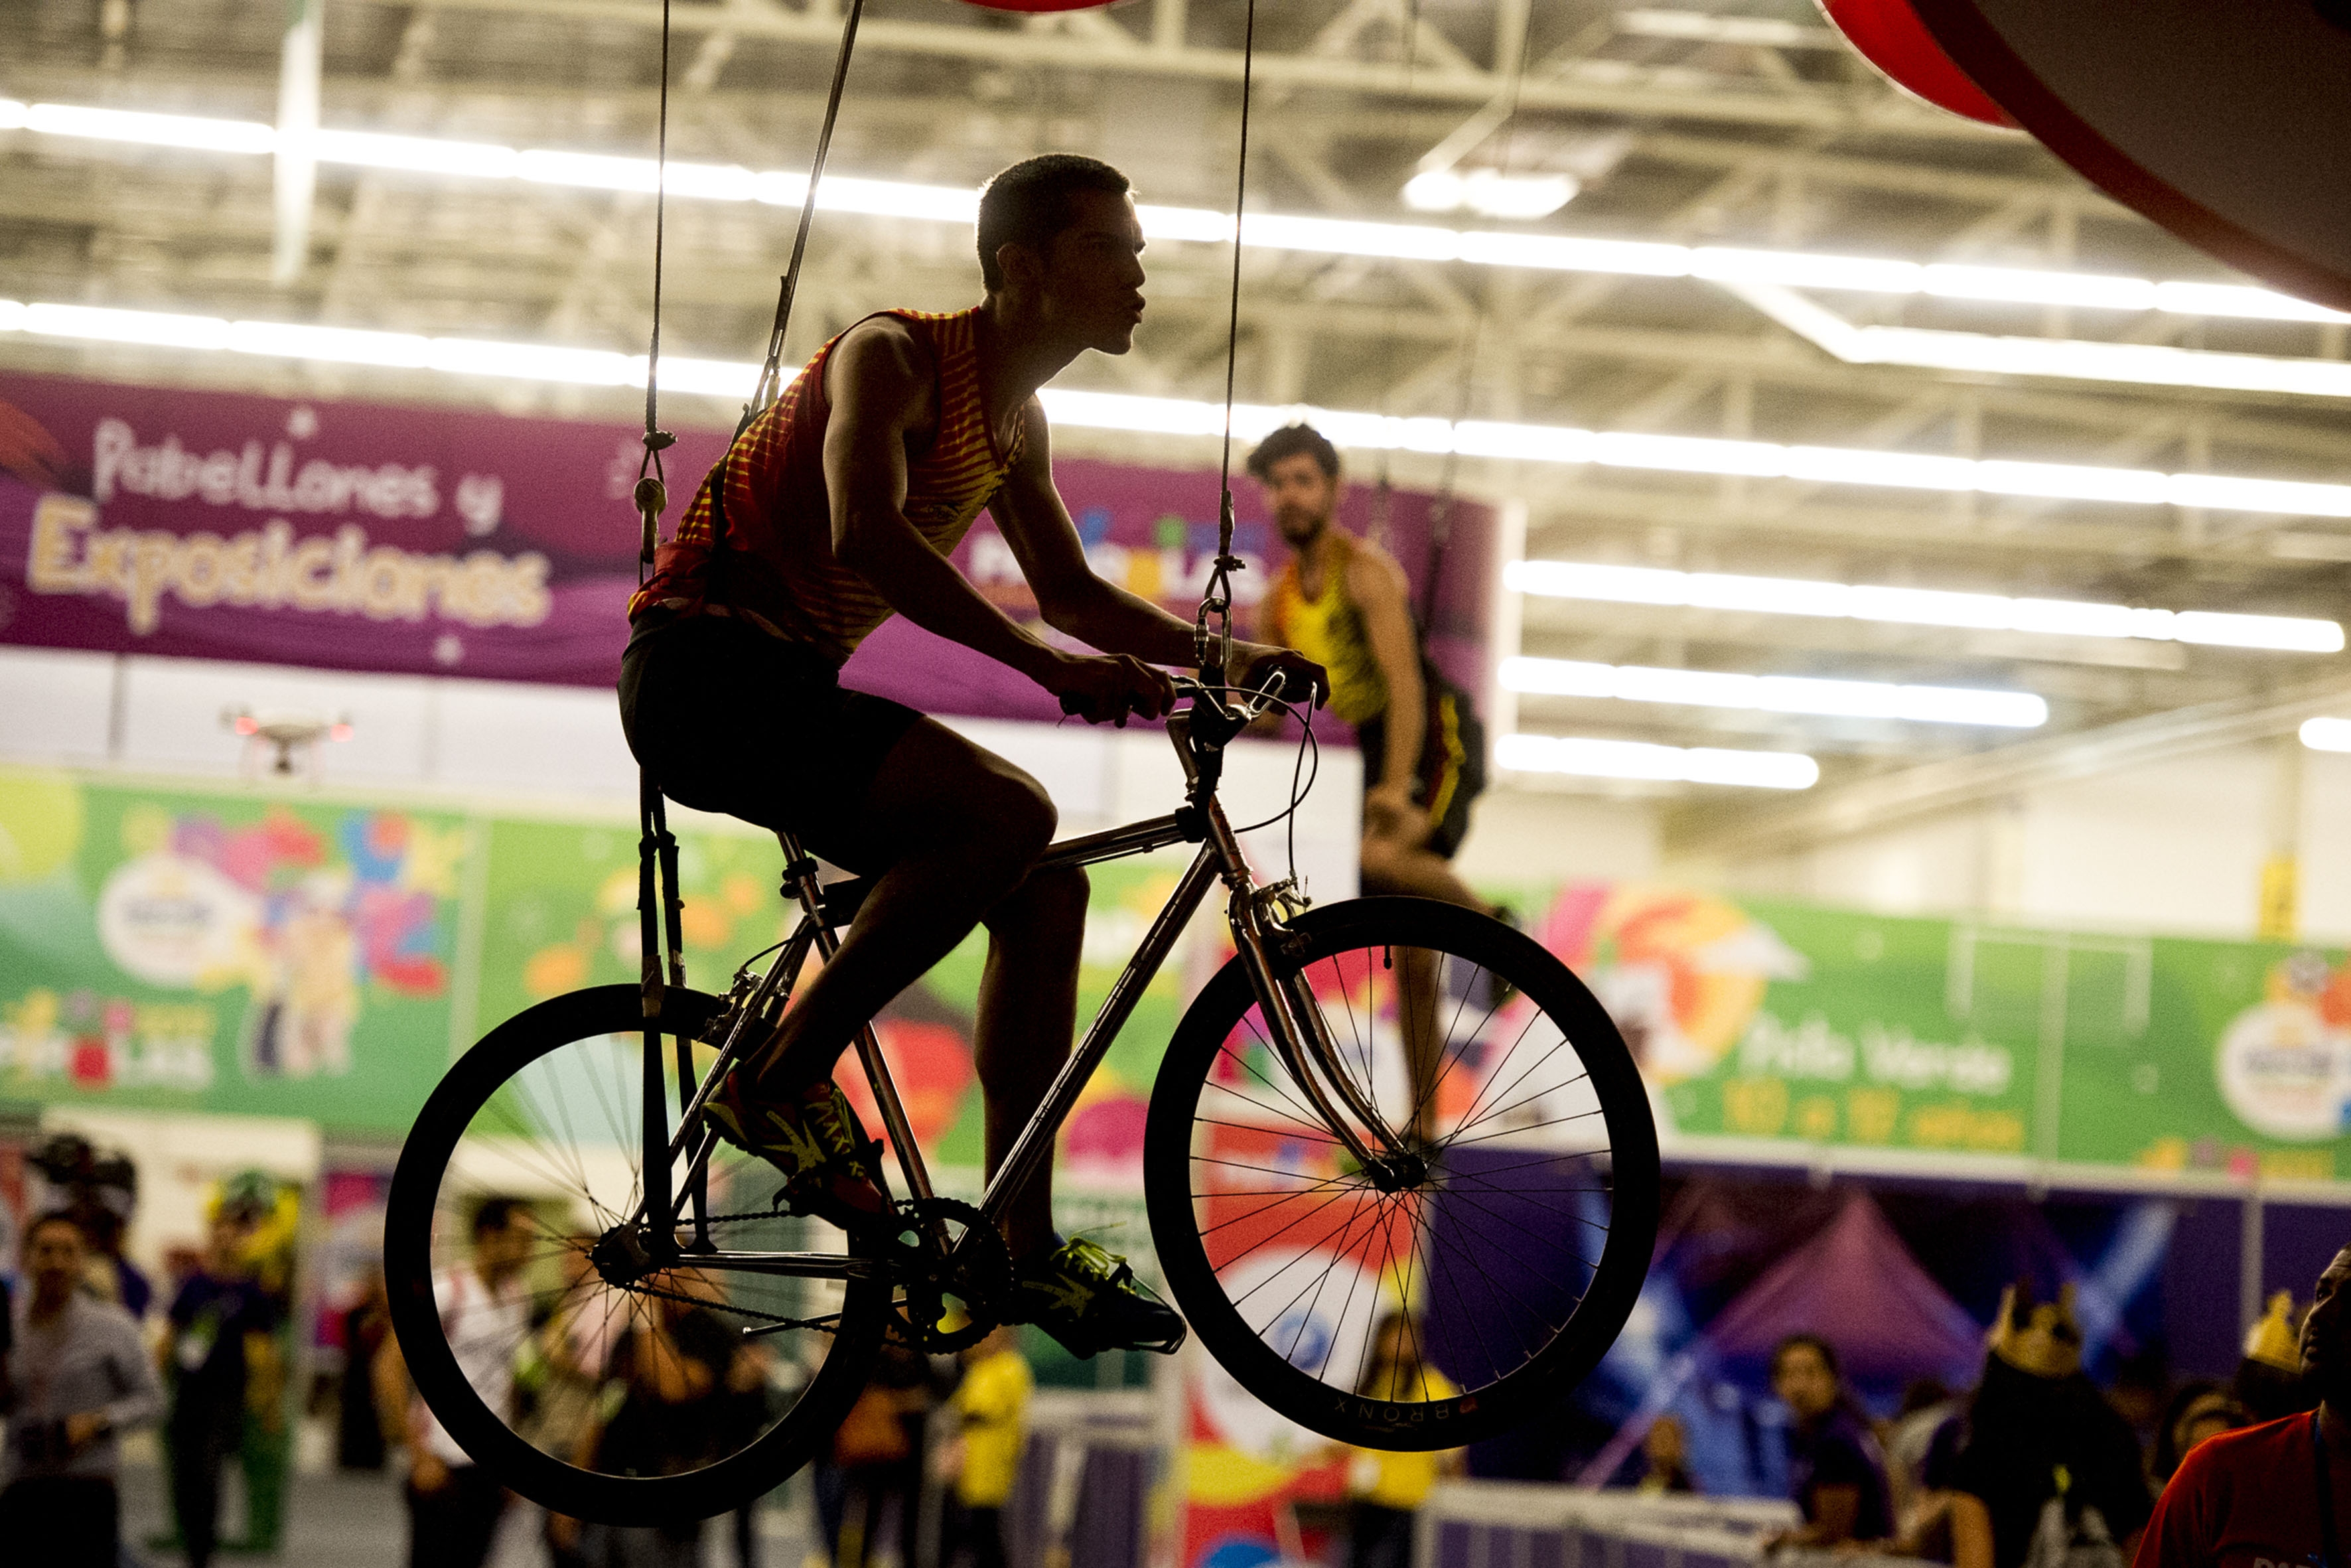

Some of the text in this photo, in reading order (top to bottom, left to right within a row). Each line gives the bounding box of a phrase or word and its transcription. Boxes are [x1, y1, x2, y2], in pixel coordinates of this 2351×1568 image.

[94, 417, 504, 537] Pabellones y
[28, 494, 552, 635] Exposiciones
[1334, 1395, 1450, 1422] BRONX
